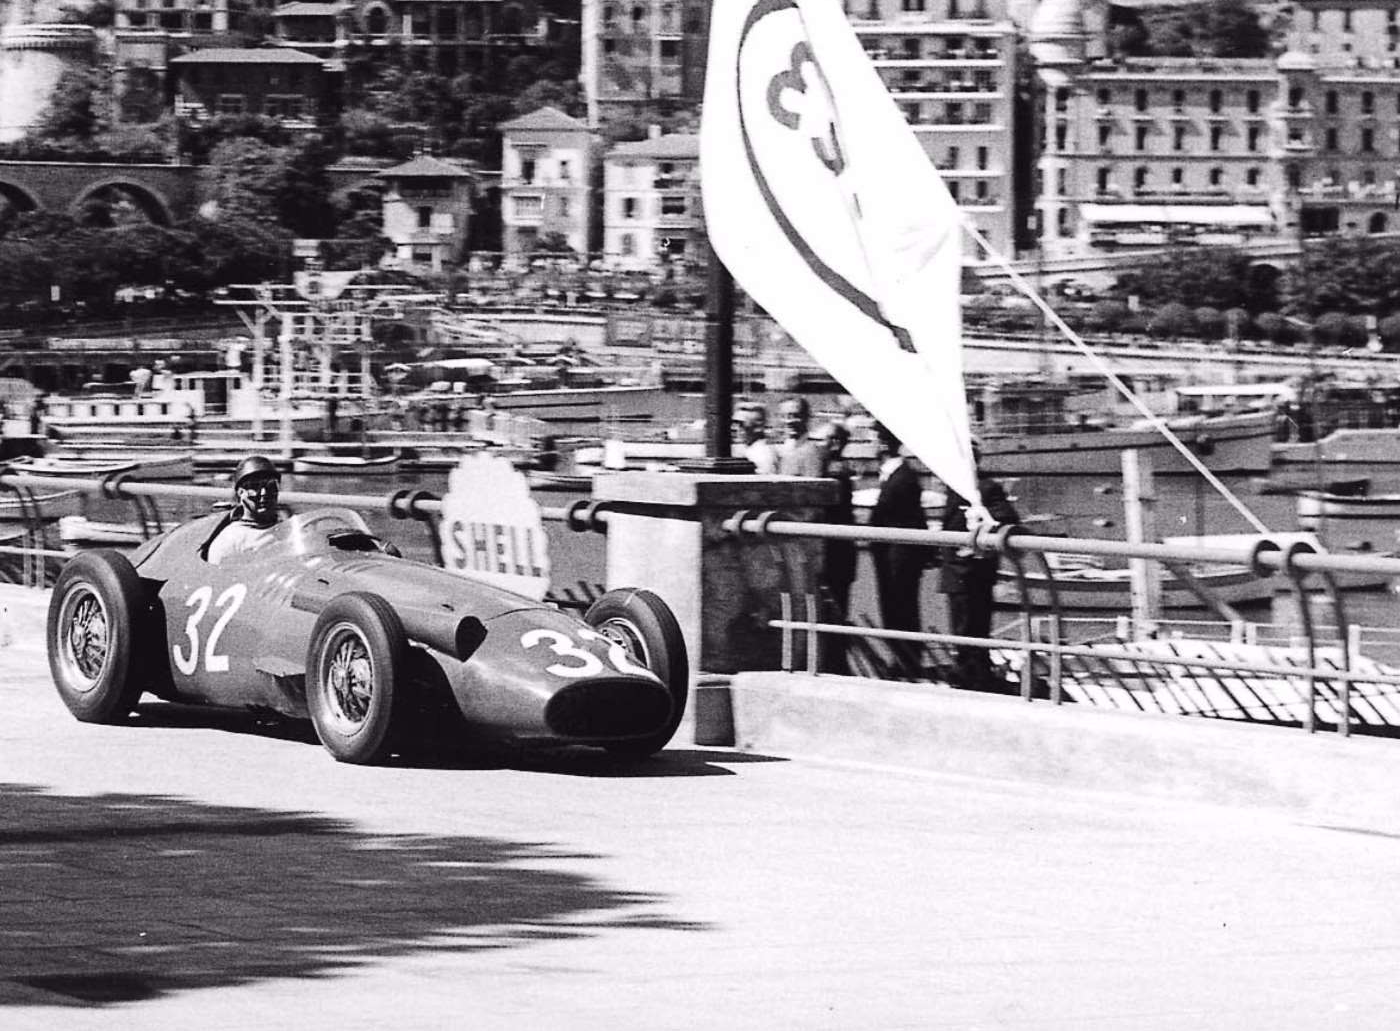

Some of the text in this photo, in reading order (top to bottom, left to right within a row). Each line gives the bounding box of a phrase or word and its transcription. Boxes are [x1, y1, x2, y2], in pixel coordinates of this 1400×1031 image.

[452, 520, 542, 577] SHELL
[172, 583, 247, 676] 32
[520, 628, 664, 684] 32
